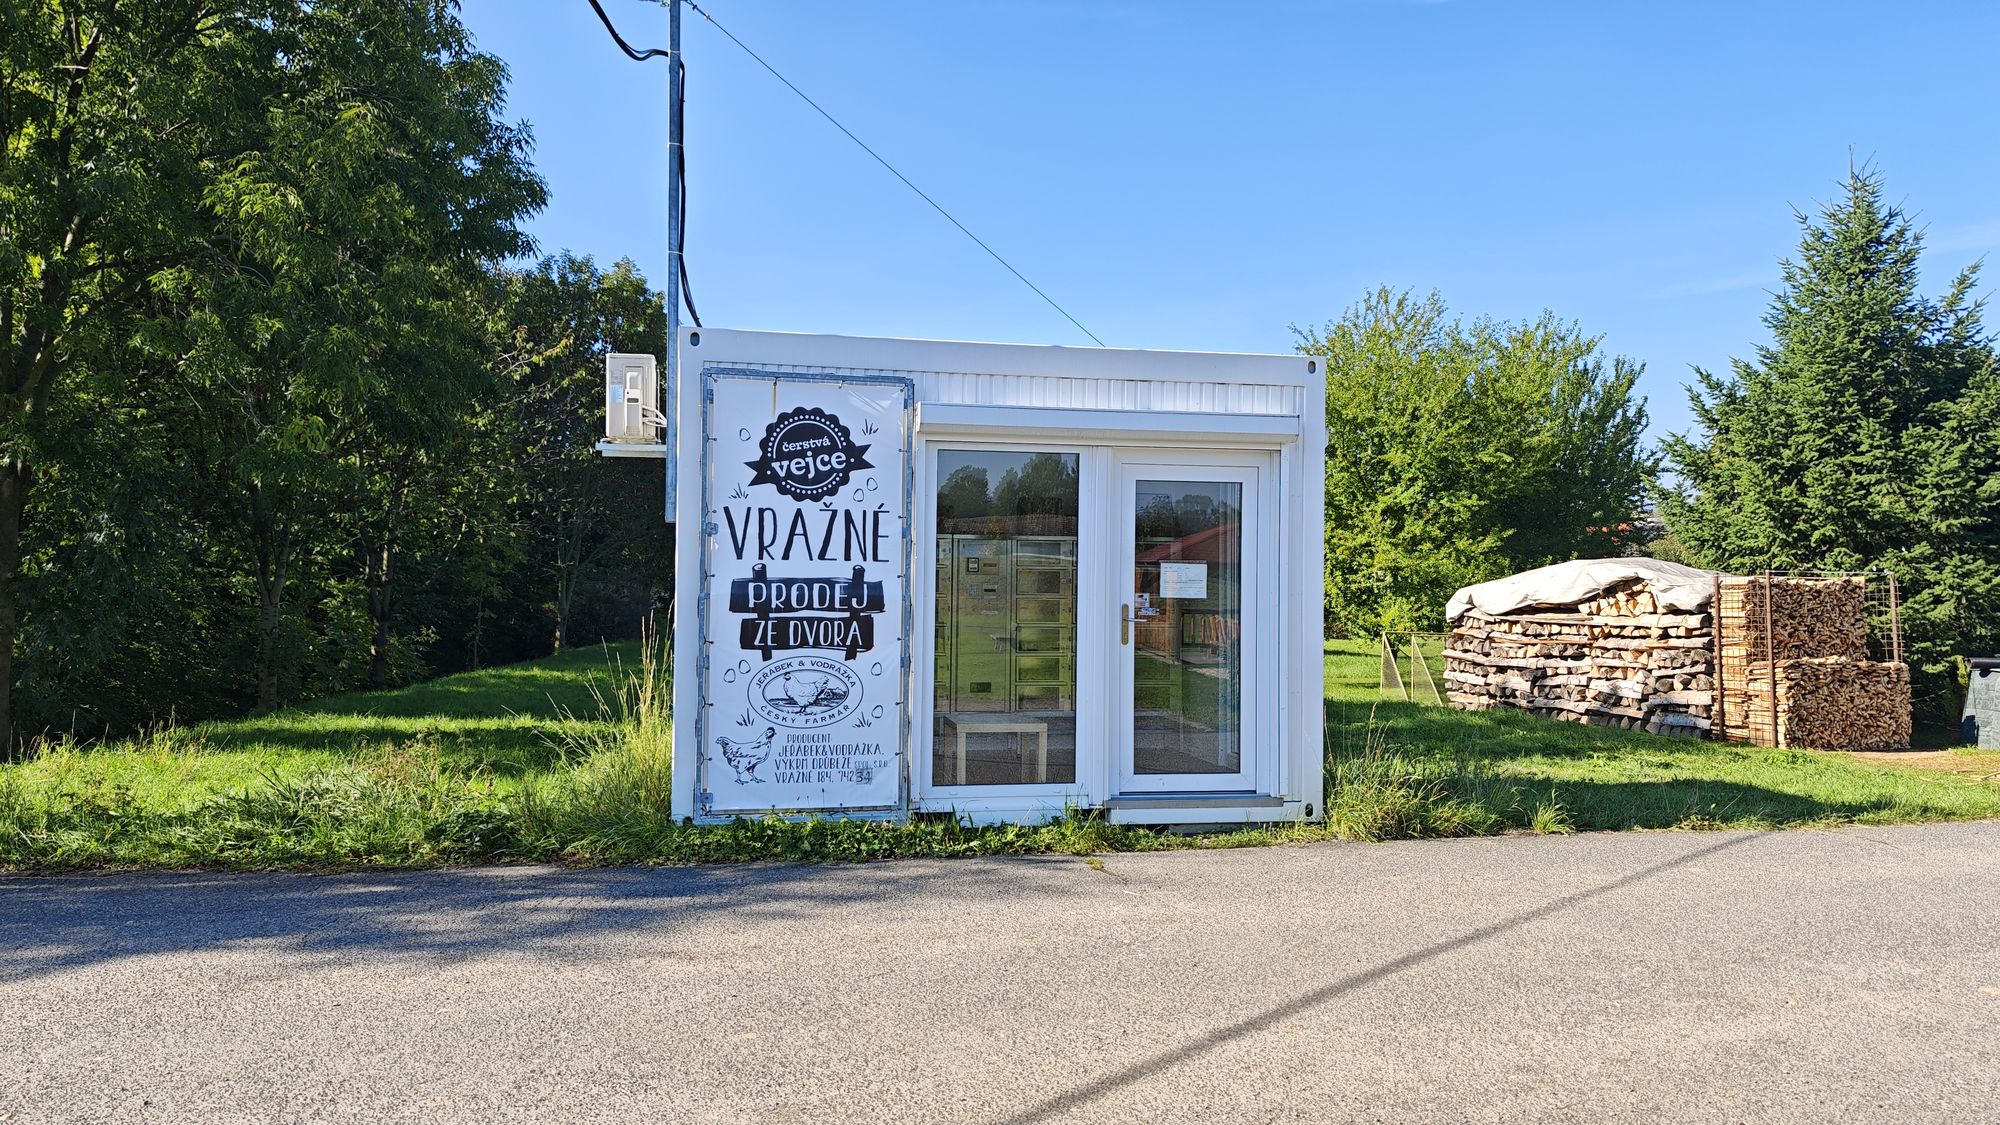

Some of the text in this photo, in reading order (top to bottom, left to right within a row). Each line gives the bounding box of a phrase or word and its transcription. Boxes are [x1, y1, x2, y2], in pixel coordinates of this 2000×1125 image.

[782, 436, 831, 452] čerstvá
[771, 450, 846, 479] vejce
[723, 501, 890, 562] VRAŽNÉ
[748, 582, 868, 609] PRODEJ
[753, 620, 862, 646] ZE DVORA
[755, 661, 794, 689] JEŘÁBEK
[810, 660, 856, 688] VODRÁŽKA
[760, 704, 797, 724] ČESKÝ
[774, 757, 808, 771] VÝKRM
[774, 770, 813, 784] VRAŽNÉ
